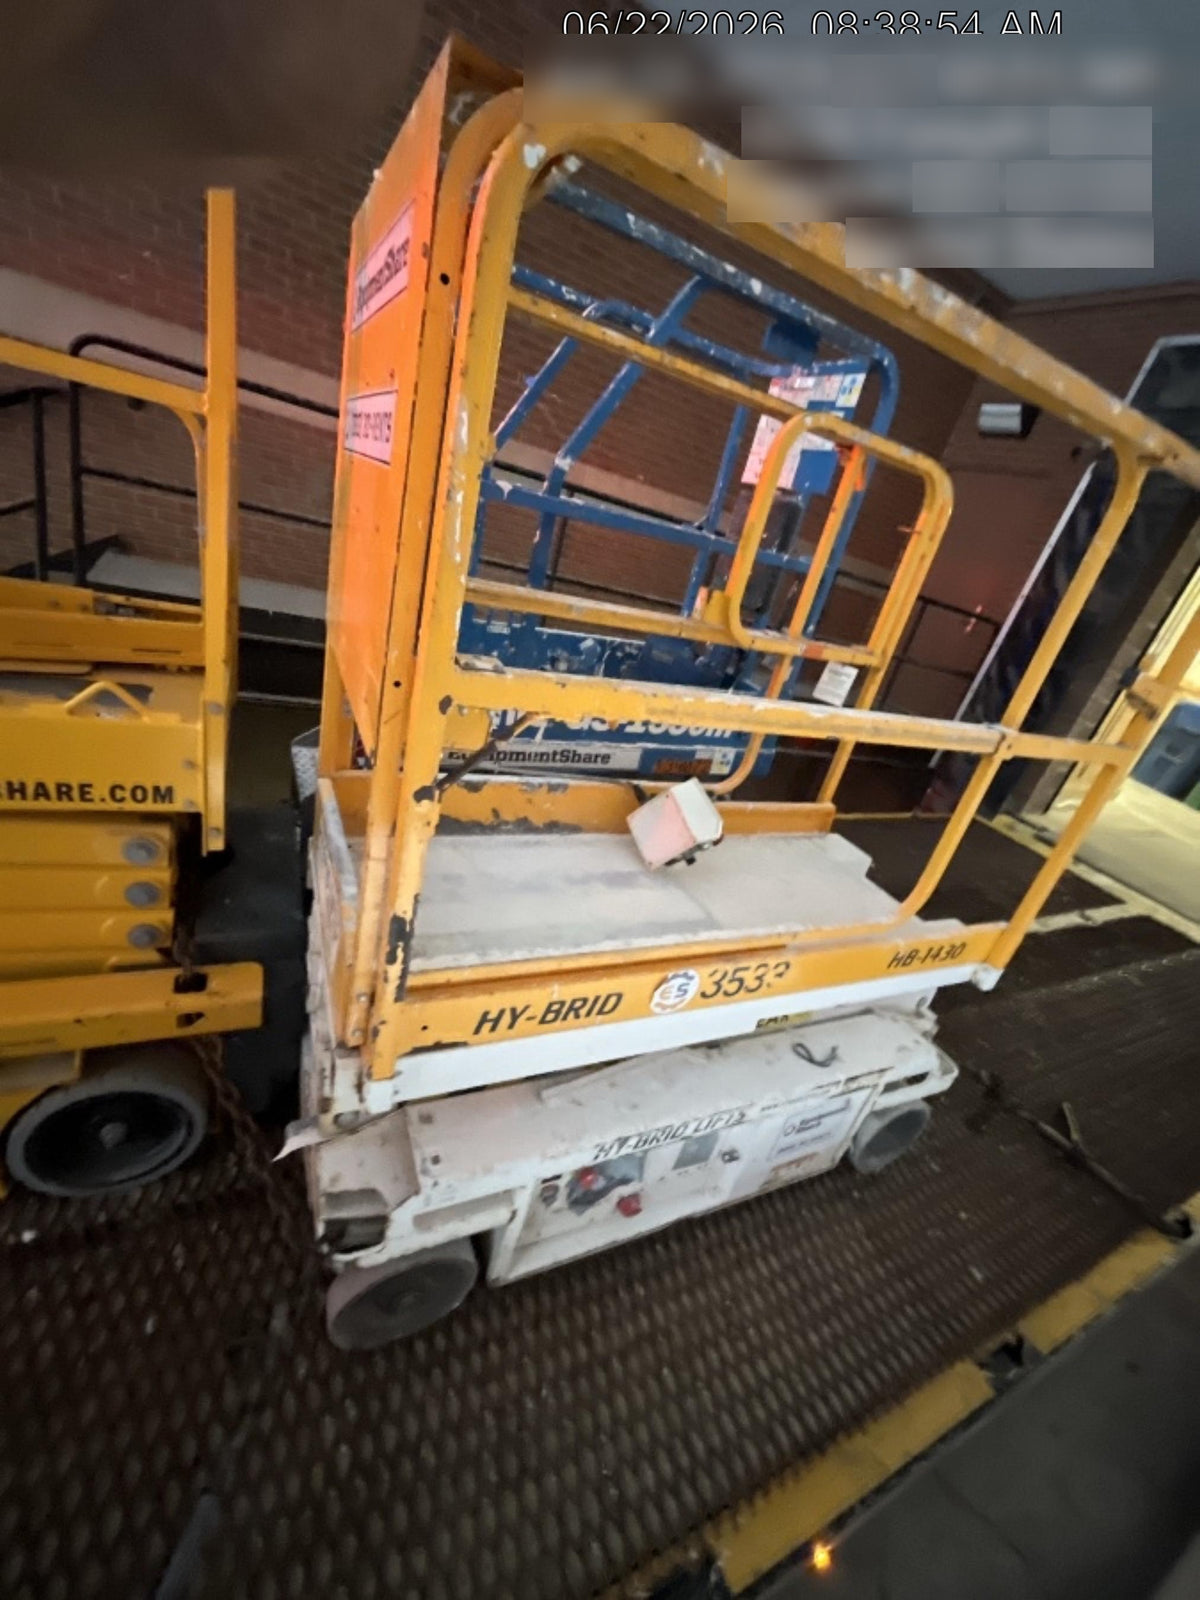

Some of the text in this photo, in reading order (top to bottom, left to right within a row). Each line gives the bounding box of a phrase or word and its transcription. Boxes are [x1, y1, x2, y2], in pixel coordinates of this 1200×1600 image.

[0, 780, 174, 804] HARE.COM
[887, 942, 967, 969] HB-1430
[472, 992, 623, 1035] HY-BRID
